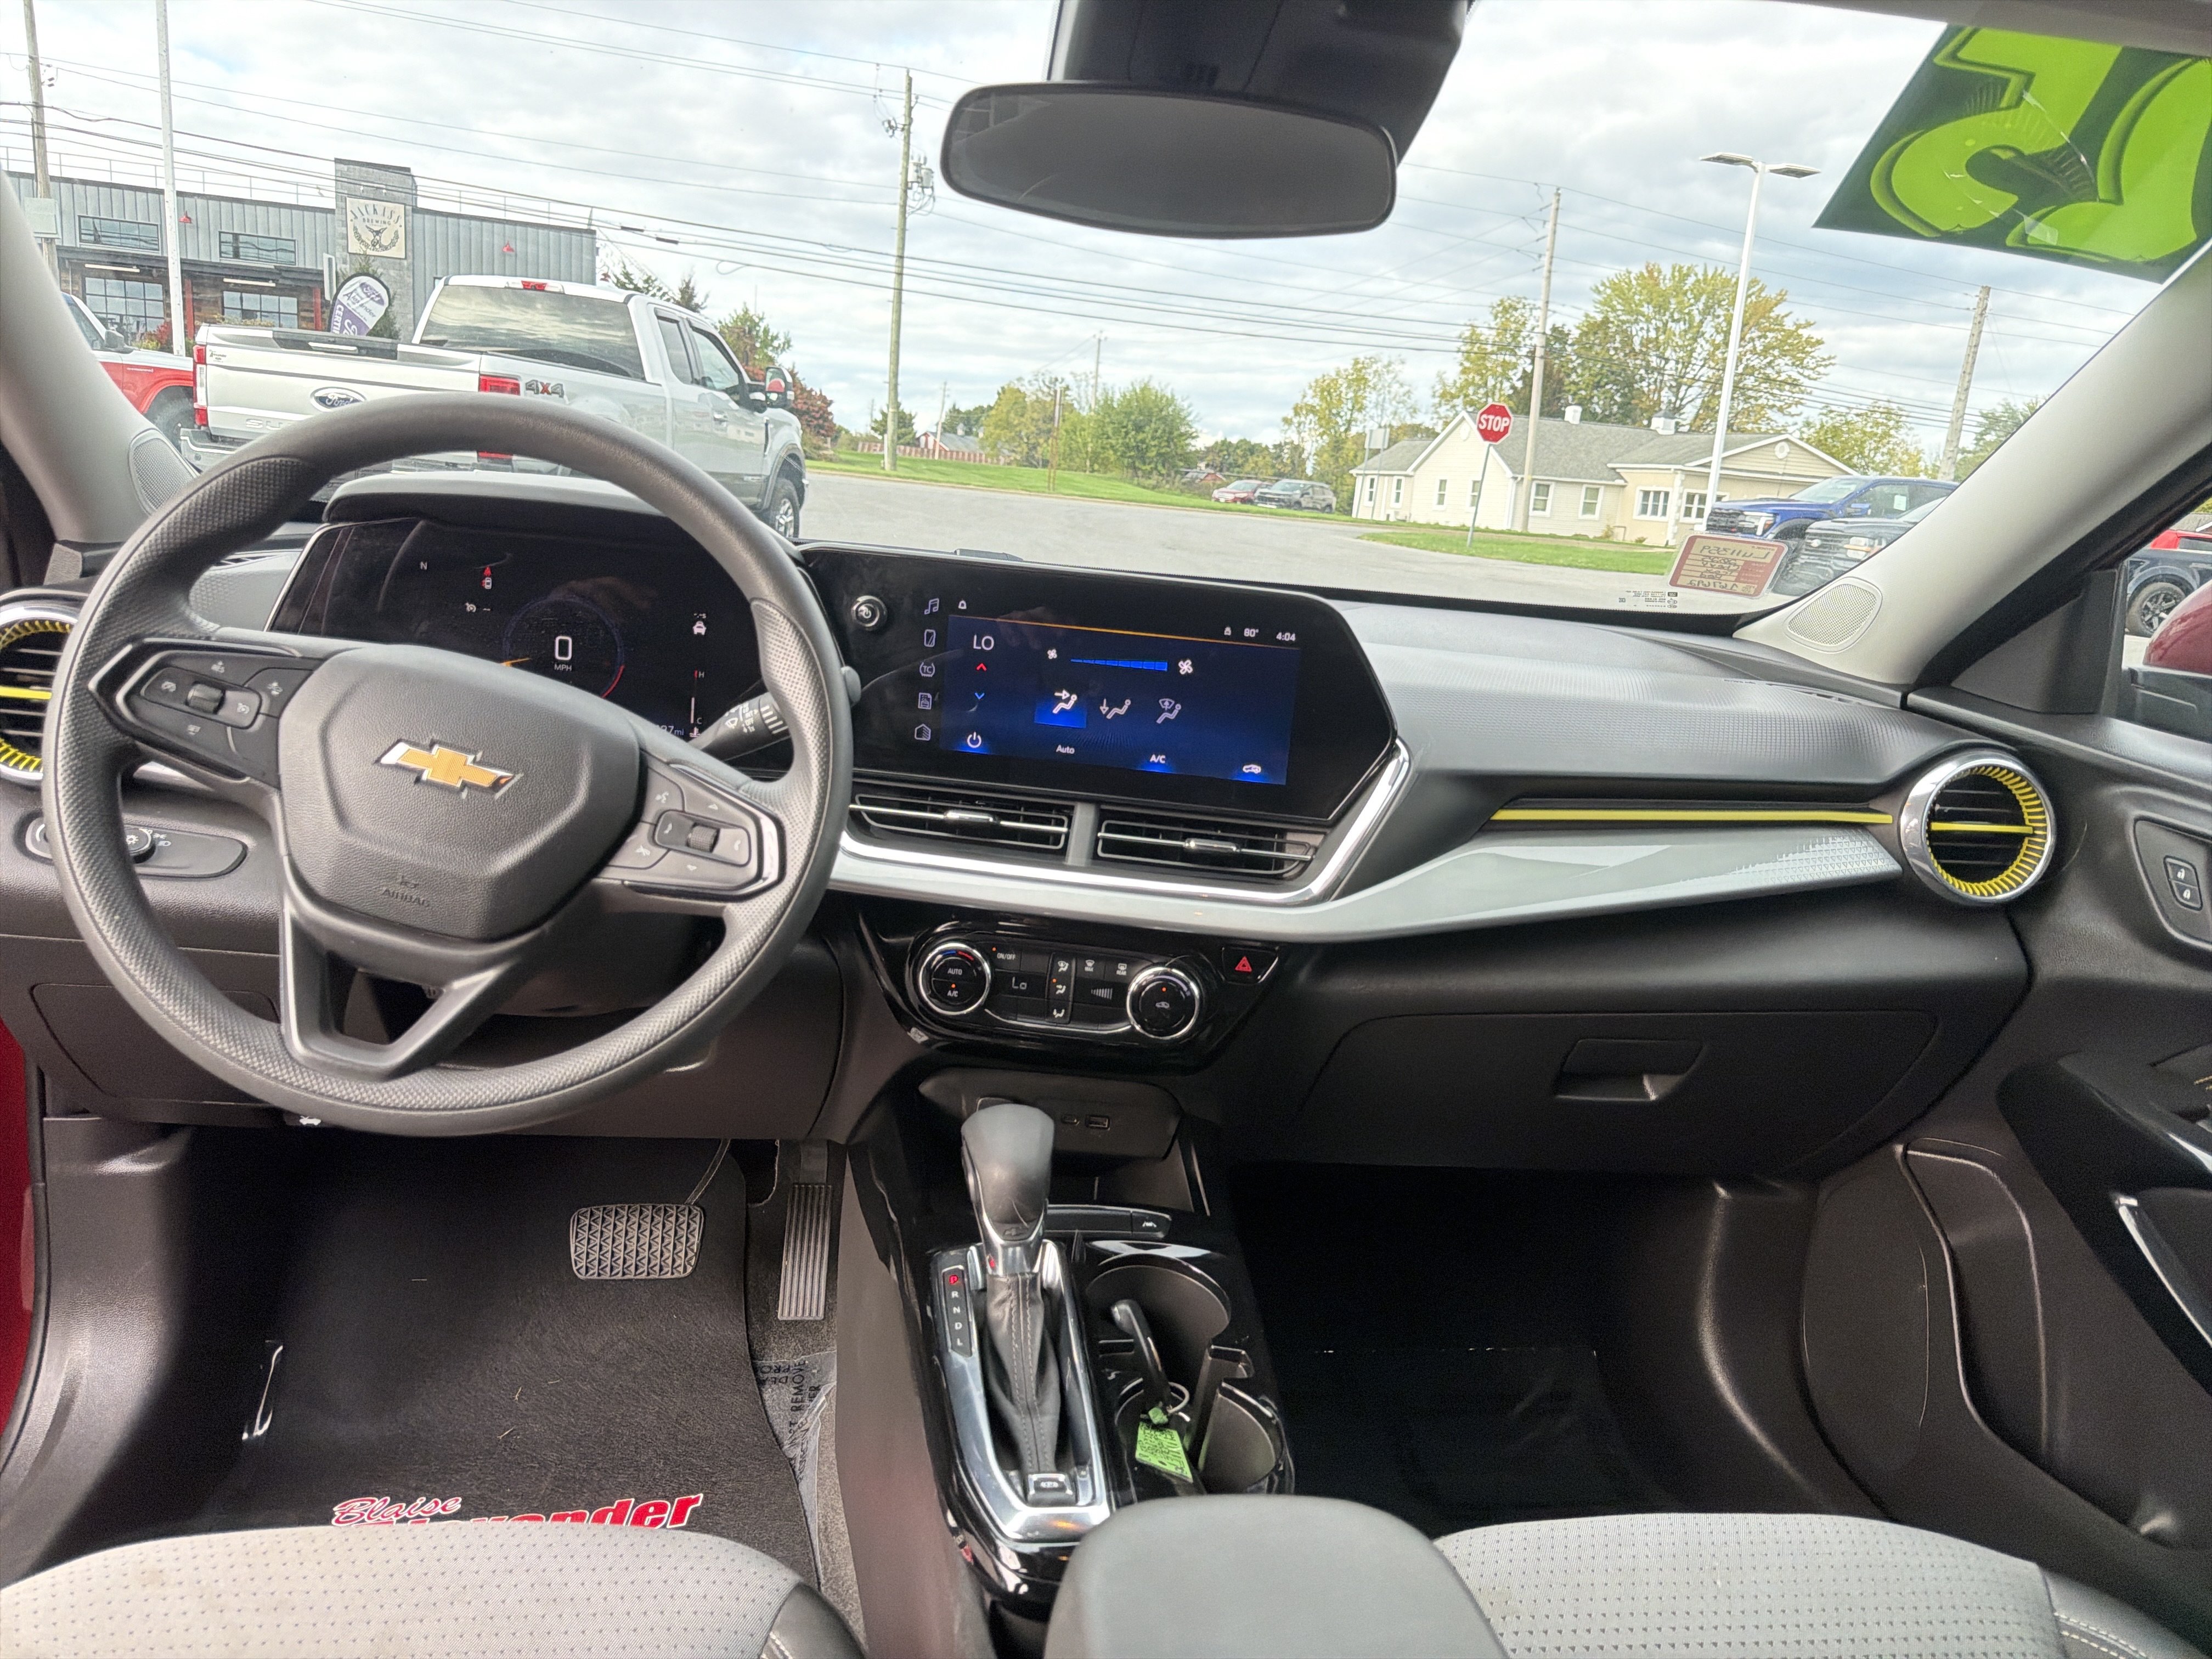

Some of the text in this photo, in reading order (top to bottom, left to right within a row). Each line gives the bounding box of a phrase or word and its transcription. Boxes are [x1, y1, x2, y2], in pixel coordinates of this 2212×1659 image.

[362, 217, 392, 225] BREWING
[325, 392, 354, 407] Ford
[1478, 414, 1510, 432] STOP
[420, 561, 427, 570] N
[1276, 631, 1296, 641] 4:04
[973, 634, 995, 651] LO
[555, 636, 572, 661] 0
[1056, 744, 1075, 754] Auto
[1149, 754, 1166, 764] A/C
[997, 952, 1016, 961] ON/OFF
[949, 1274, 958, 1284] P
[952, 1306, 961, 1314] N
[955, 1322, 963, 1330] D
[957, 1338, 963, 1346] L
[791, 1359, 806, 1413] REMOVE
[332, 1496, 462, 1526] Blaise
